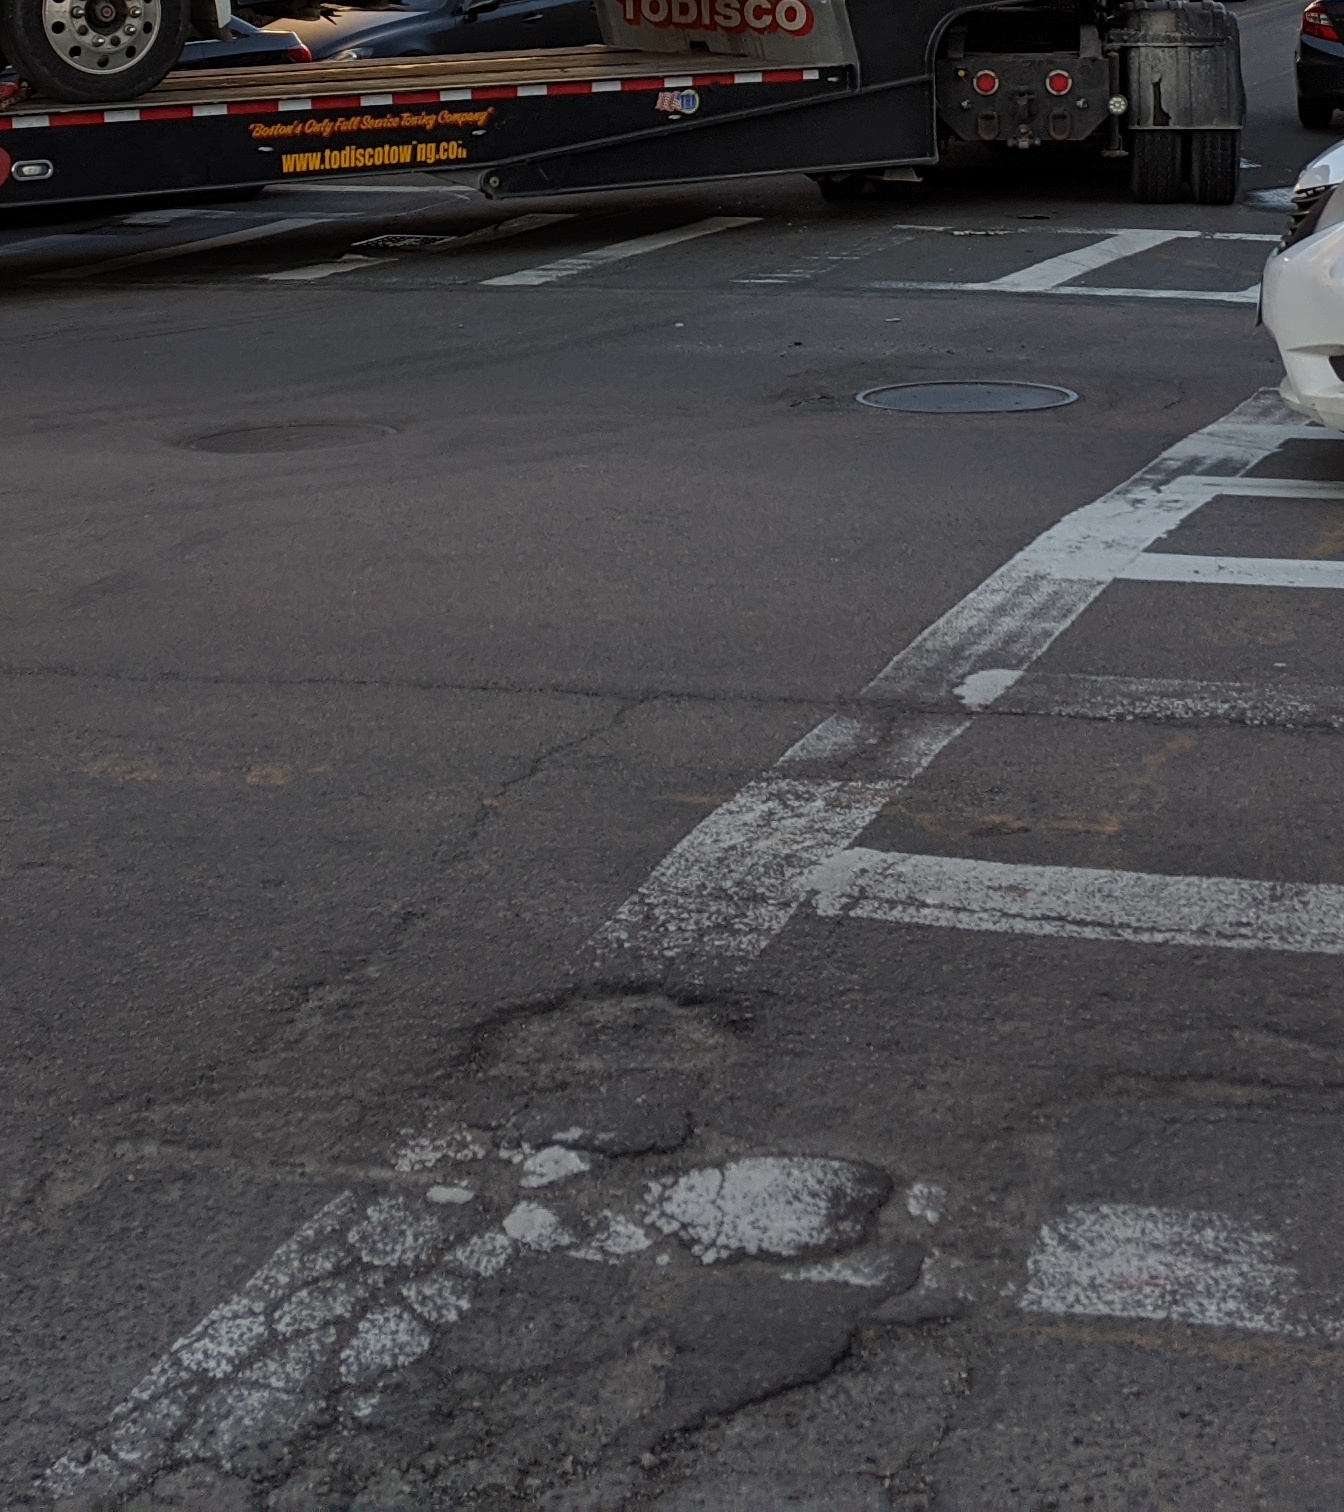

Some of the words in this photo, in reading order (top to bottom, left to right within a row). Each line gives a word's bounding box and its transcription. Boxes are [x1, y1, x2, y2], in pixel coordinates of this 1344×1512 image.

[305, 118, 332, 137] Only
[334, 114, 359, 132] Full
[359, 114, 400, 131] Service
[400, 111, 437, 131] Towing
[282, 139, 467, 174] www.todiscotowng.co
